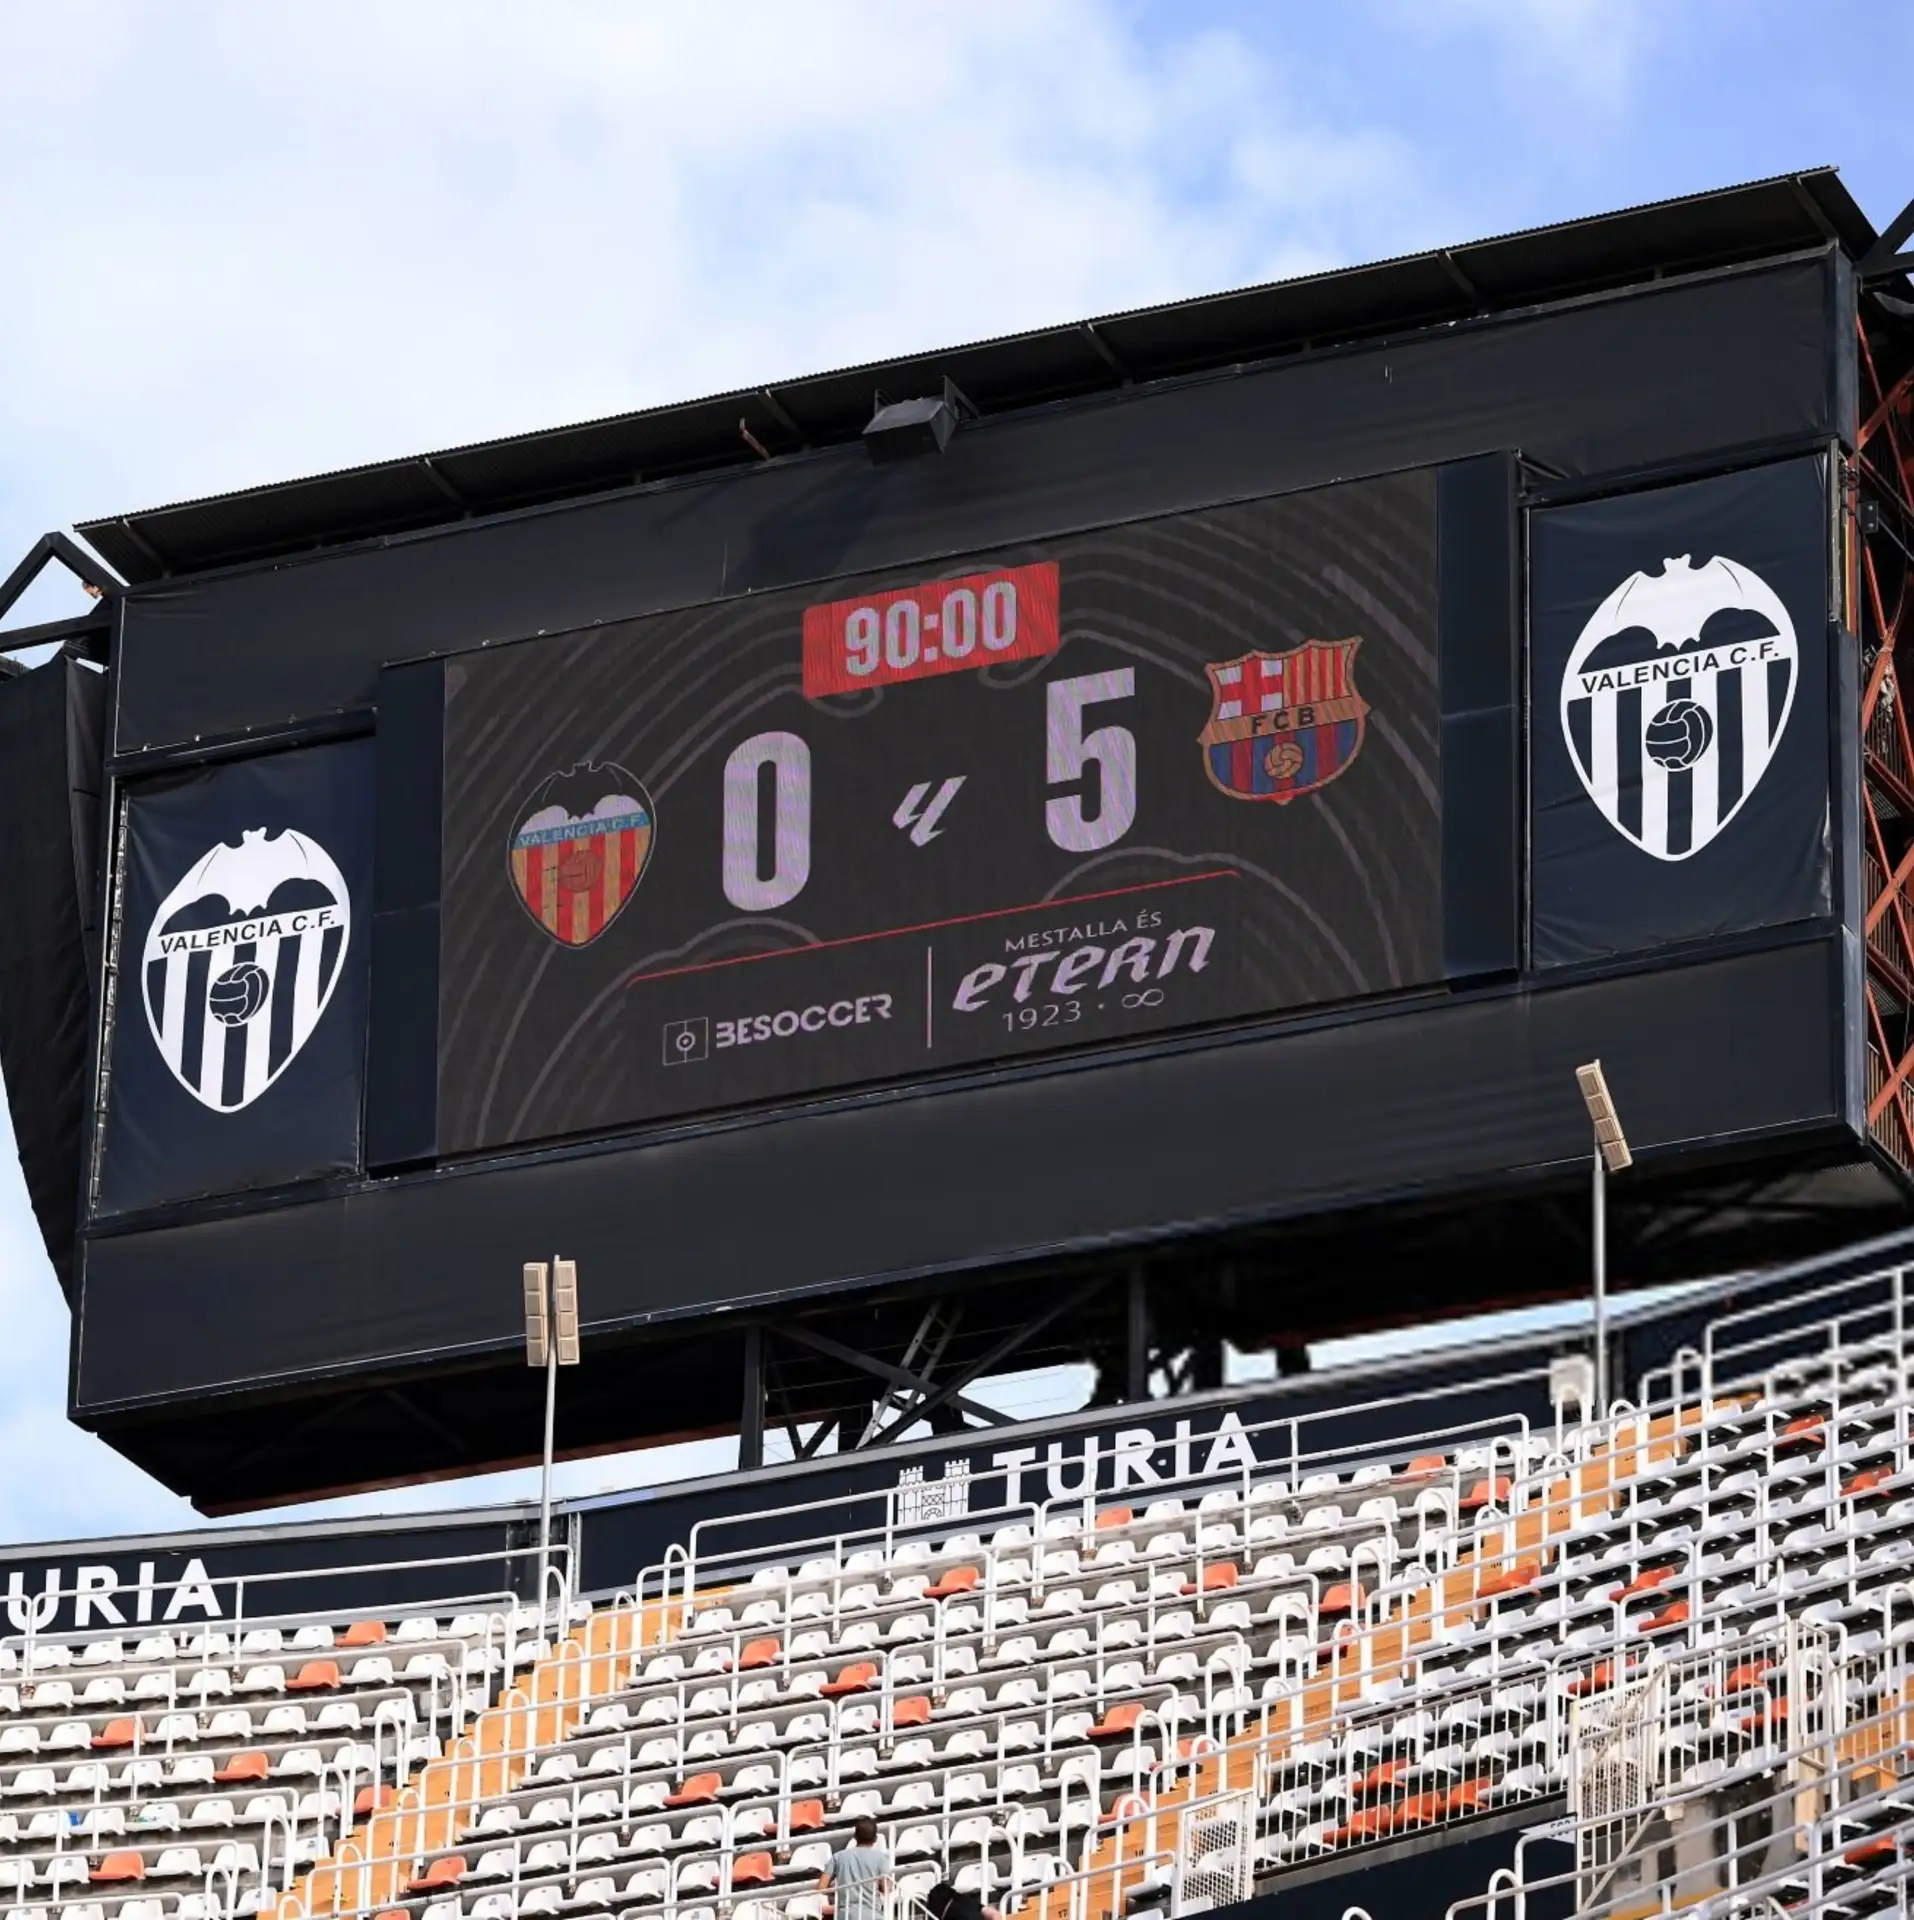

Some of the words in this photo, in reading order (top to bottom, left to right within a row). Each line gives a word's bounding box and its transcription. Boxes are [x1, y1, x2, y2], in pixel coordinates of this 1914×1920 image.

[845, 580, 1017, 677] 90:00
[1581, 652, 1720, 693] VALENCIA
[1730, 641, 1780, 664] C.F.
[1045, 666, 1137, 853] 5
[520, 823, 607, 846] VALENCIA
[722, 730, 812, 912] 0
[160, 920, 282, 954] VALENCIA
[292, 910, 335, 933] C.F.
[1005, 918, 1128, 953] MESTALLA
[1136, 909, 1162, 929] ÉS
[716, 993, 892, 1049] BESOCCER
[1002, 1001, 1082, 1032] 1923
[992, 1412, 1258, 1506] TURIA
[7, 1558, 223, 1632] URIA
